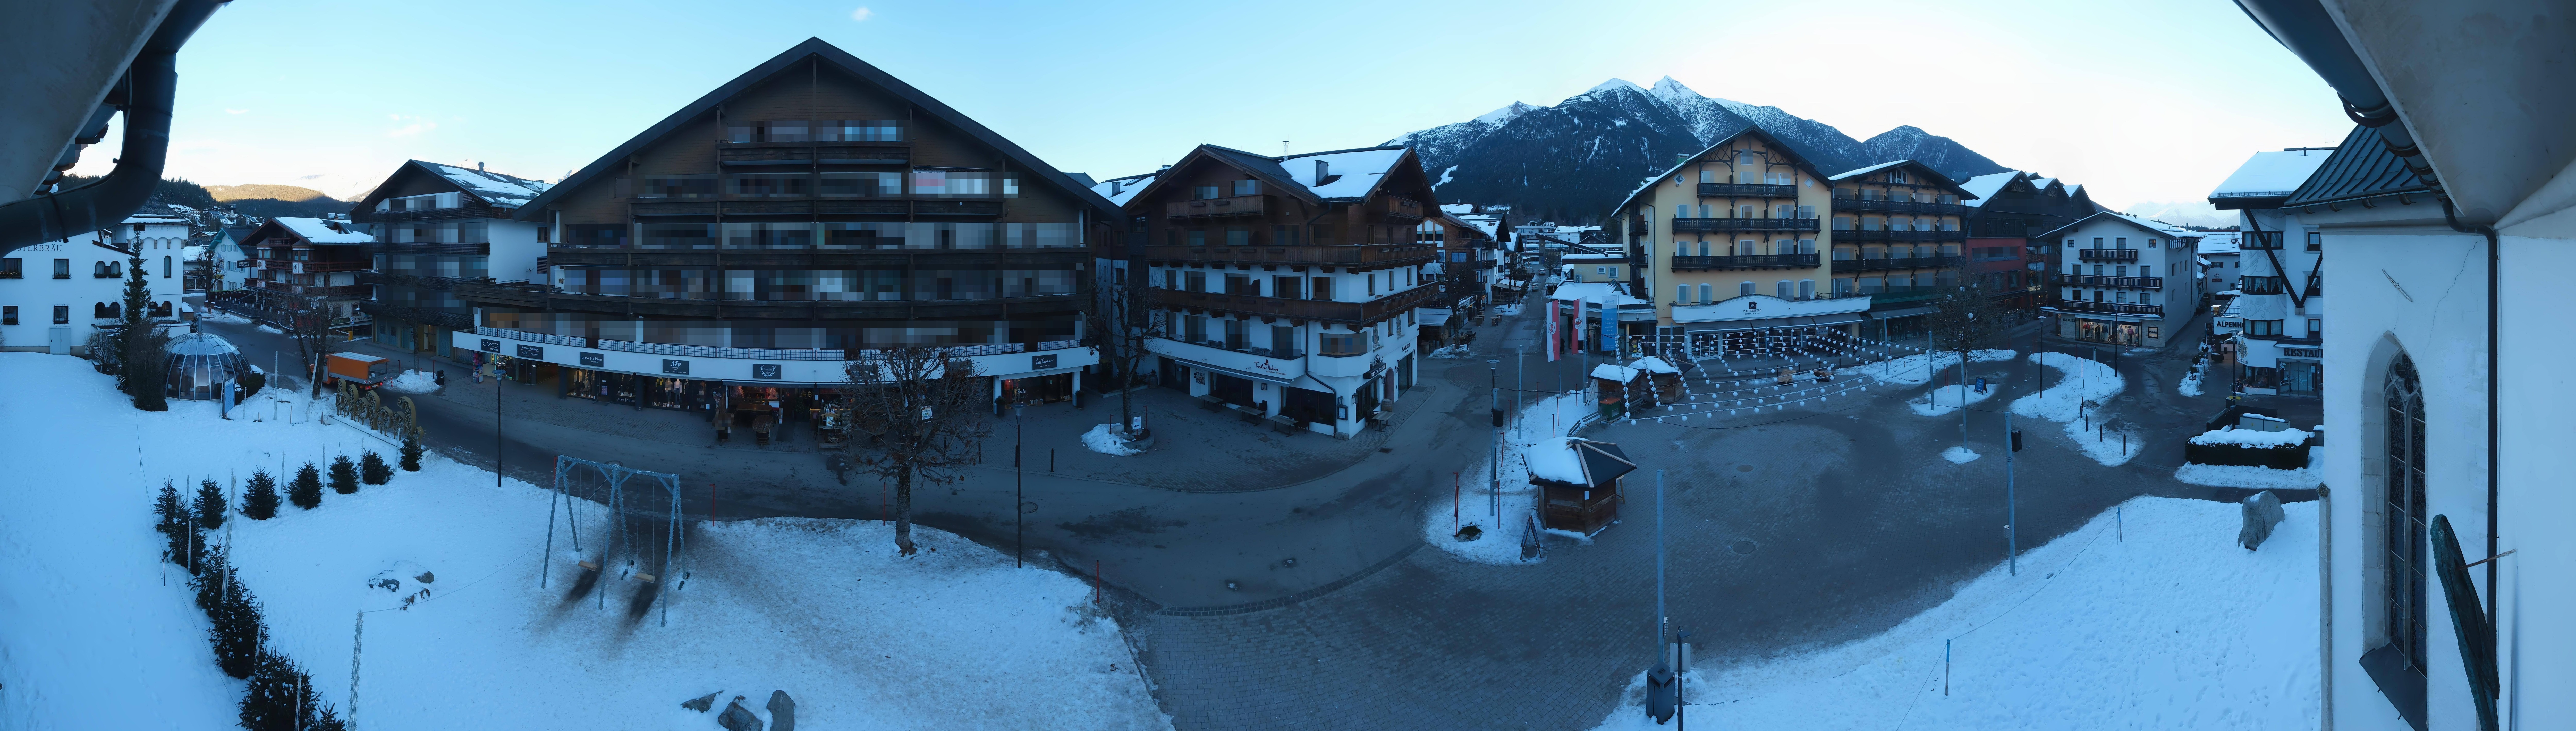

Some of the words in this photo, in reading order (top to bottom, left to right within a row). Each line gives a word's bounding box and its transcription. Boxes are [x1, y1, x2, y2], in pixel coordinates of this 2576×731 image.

[1402, 343, 1410, 352] SAILER
[670, 361, 681, 370] My
[1371, 364, 1385, 377] RESTAURANT
